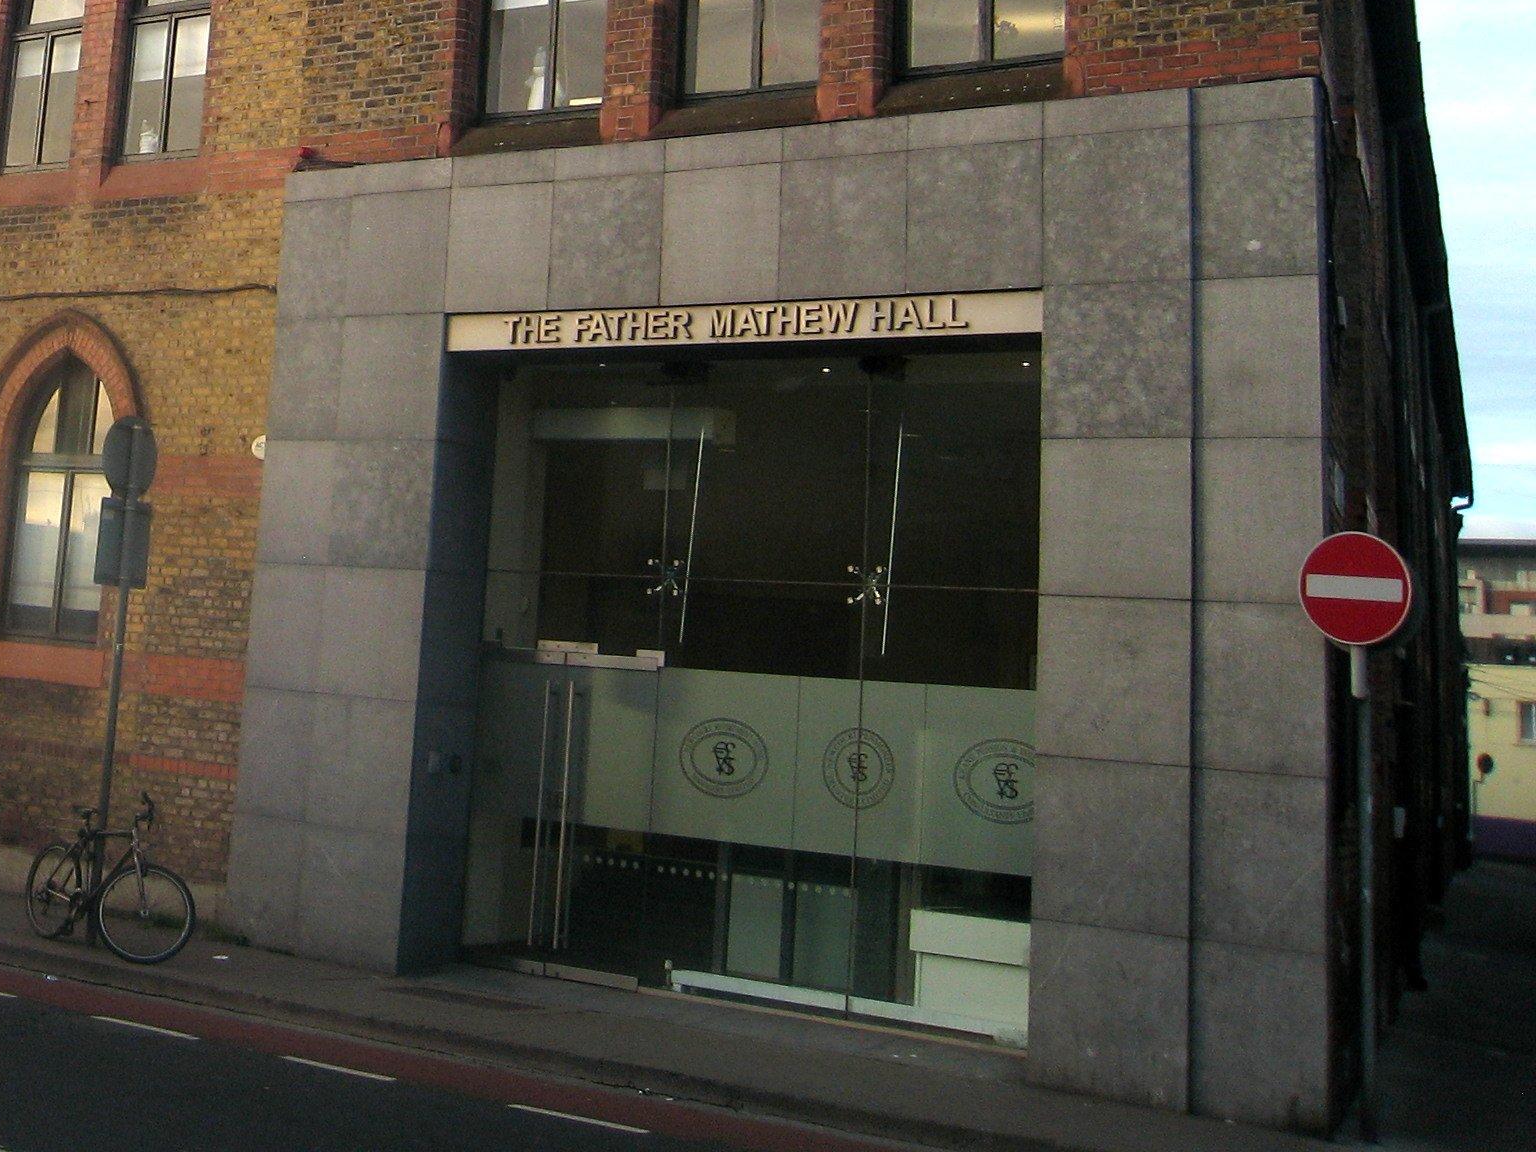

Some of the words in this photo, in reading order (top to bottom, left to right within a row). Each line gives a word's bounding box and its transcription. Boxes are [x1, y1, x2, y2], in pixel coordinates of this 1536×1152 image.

[504, 314, 561, 345] THE
[573, 309, 693, 343] FATHER
[709, 301, 860, 338] MATHEW
[871, 298, 969, 332] HALL
